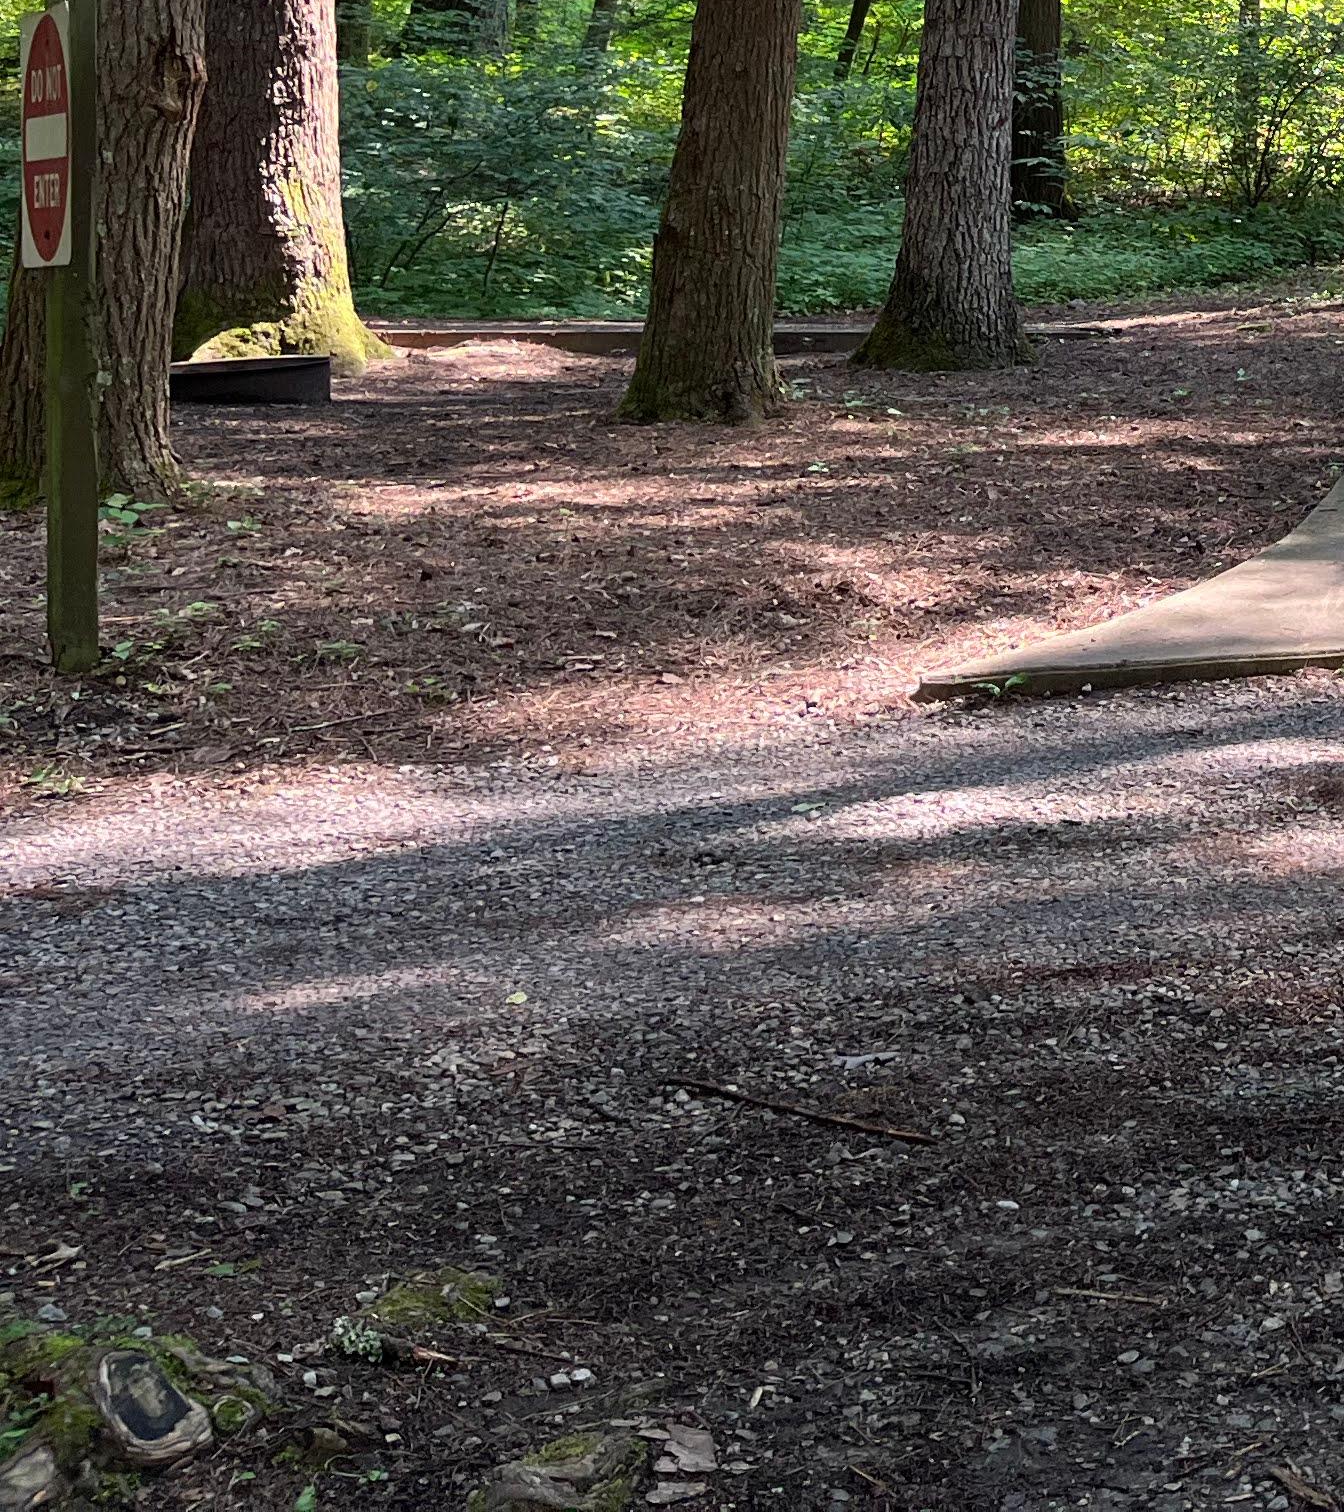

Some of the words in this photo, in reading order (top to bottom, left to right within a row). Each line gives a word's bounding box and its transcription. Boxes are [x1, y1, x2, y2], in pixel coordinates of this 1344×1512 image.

[31, 68, 43, 103] DO
[46, 64, 61, 102] NOT
[34, 173, 60, 208] ENTER
